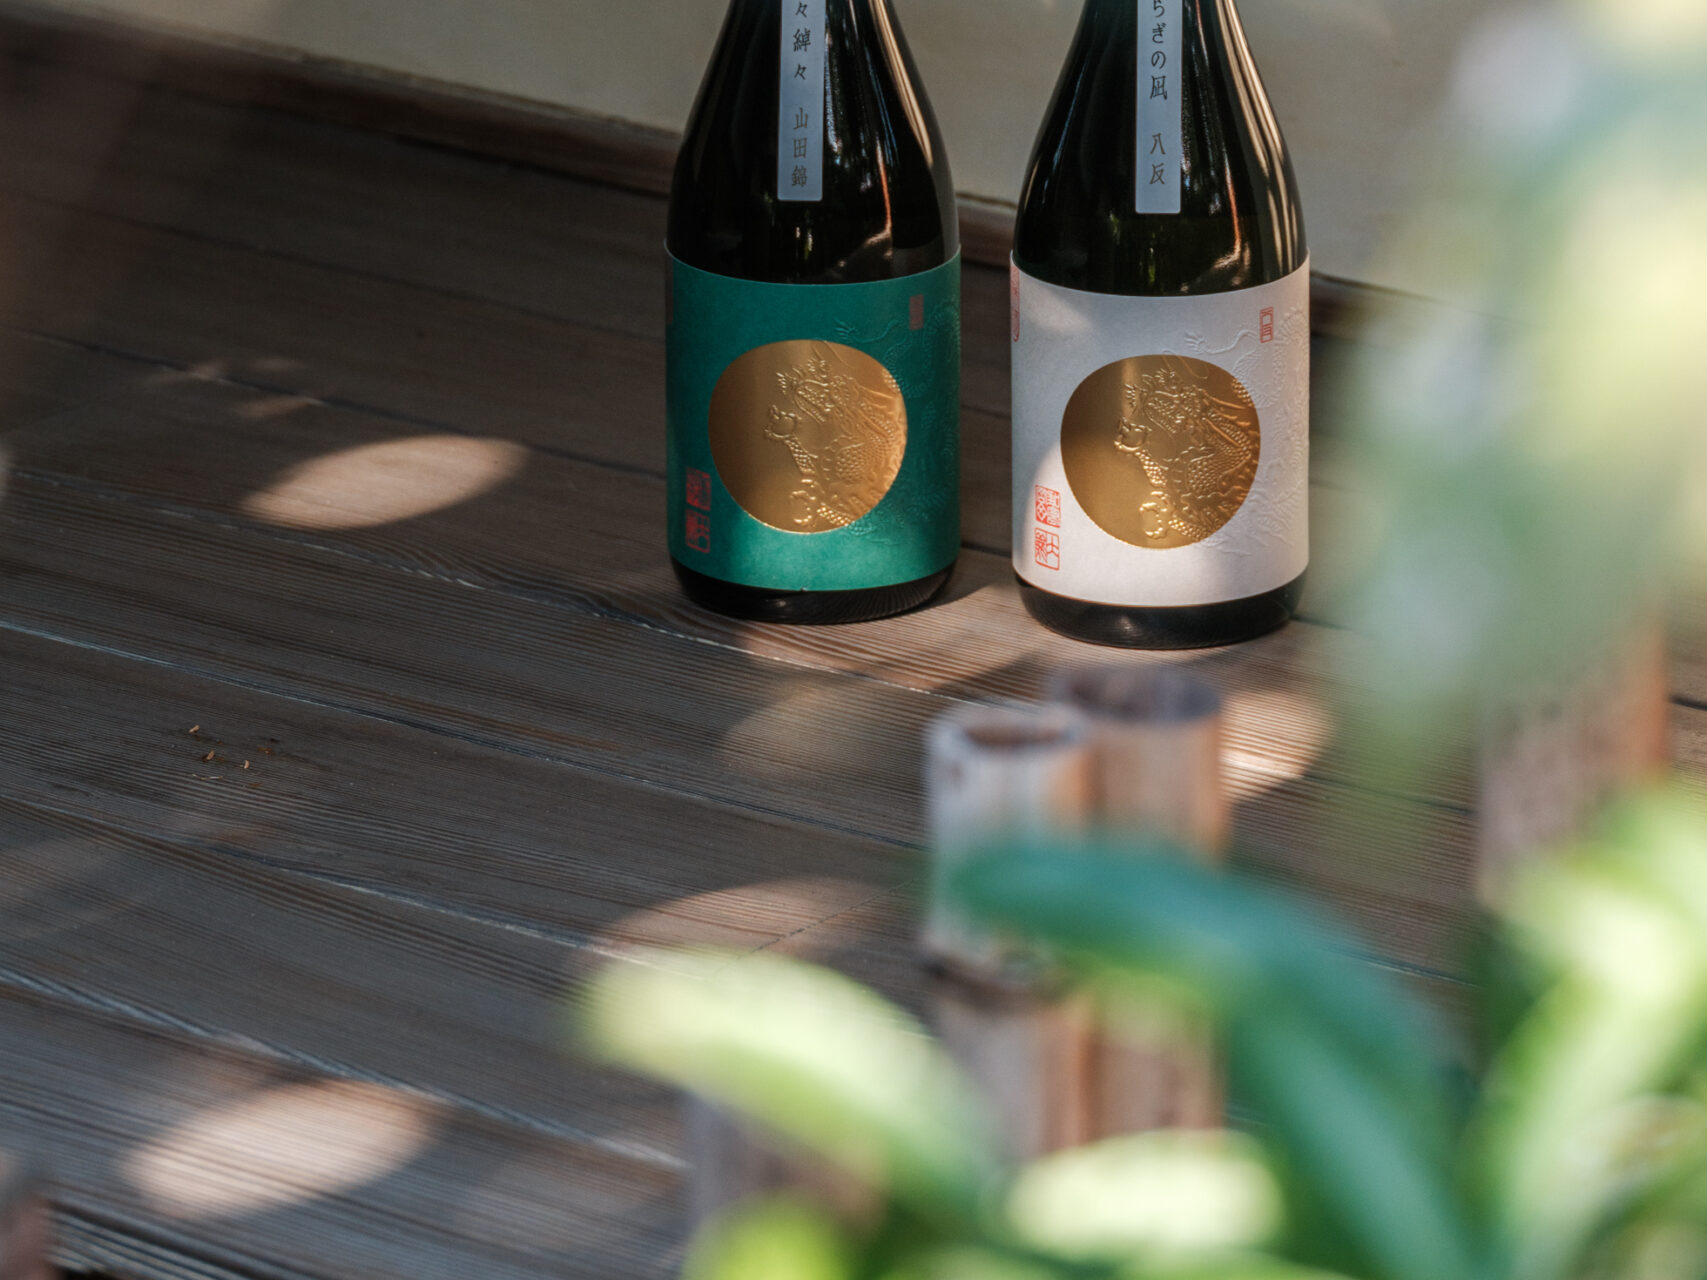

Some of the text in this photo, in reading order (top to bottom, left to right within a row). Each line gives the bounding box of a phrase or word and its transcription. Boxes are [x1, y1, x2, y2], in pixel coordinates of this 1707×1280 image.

[791, 108, 809, 188] 山田錦
[1149, 132, 1166, 185] 八反
